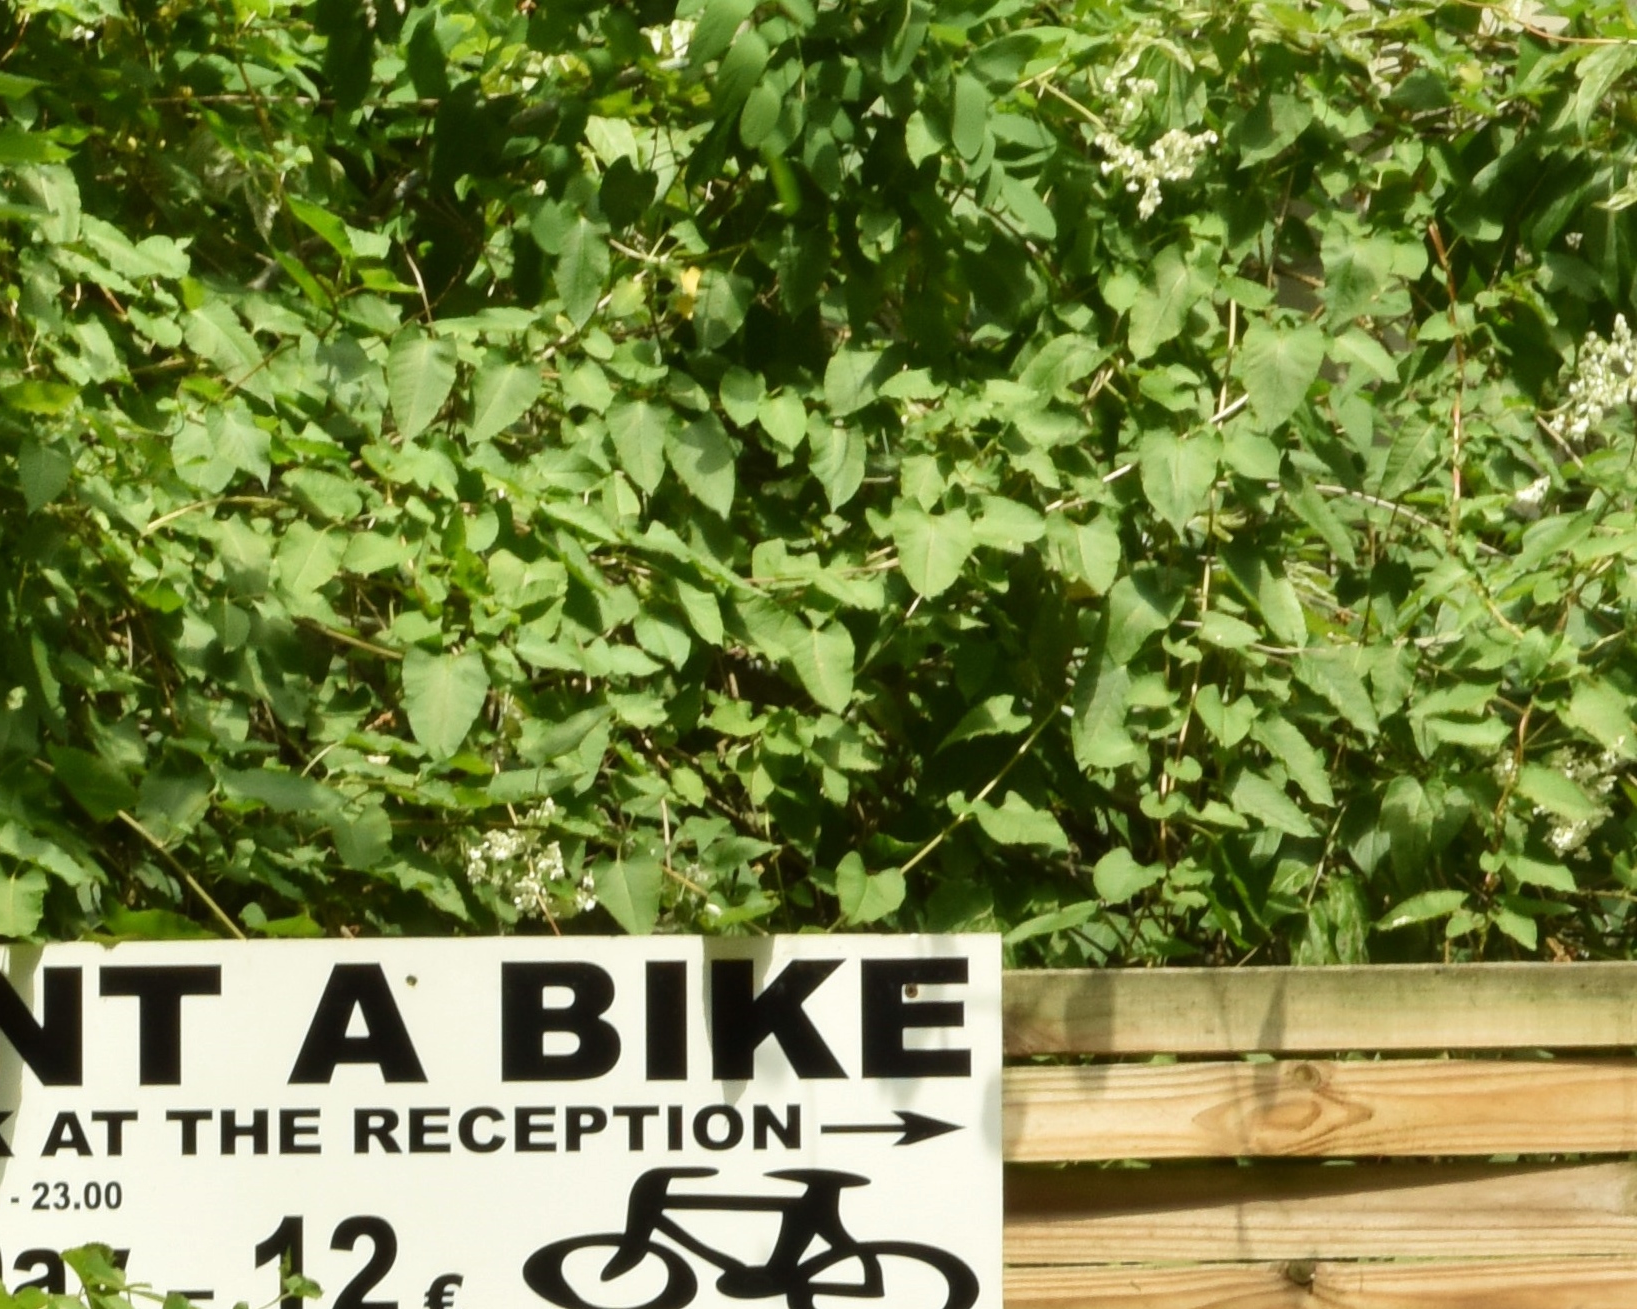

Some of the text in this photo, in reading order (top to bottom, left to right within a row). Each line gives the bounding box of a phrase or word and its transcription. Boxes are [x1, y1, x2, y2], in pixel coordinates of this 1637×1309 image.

[287, 962, 429, 1085] A
[501, 956, 973, 1083] BIKE
[40, 1110, 139, 1158] AT
[165, 1107, 323, 1156] THE
[353, 1103, 803, 1155] RECEPTION
[31, 1180, 123, 1212] 23.00
